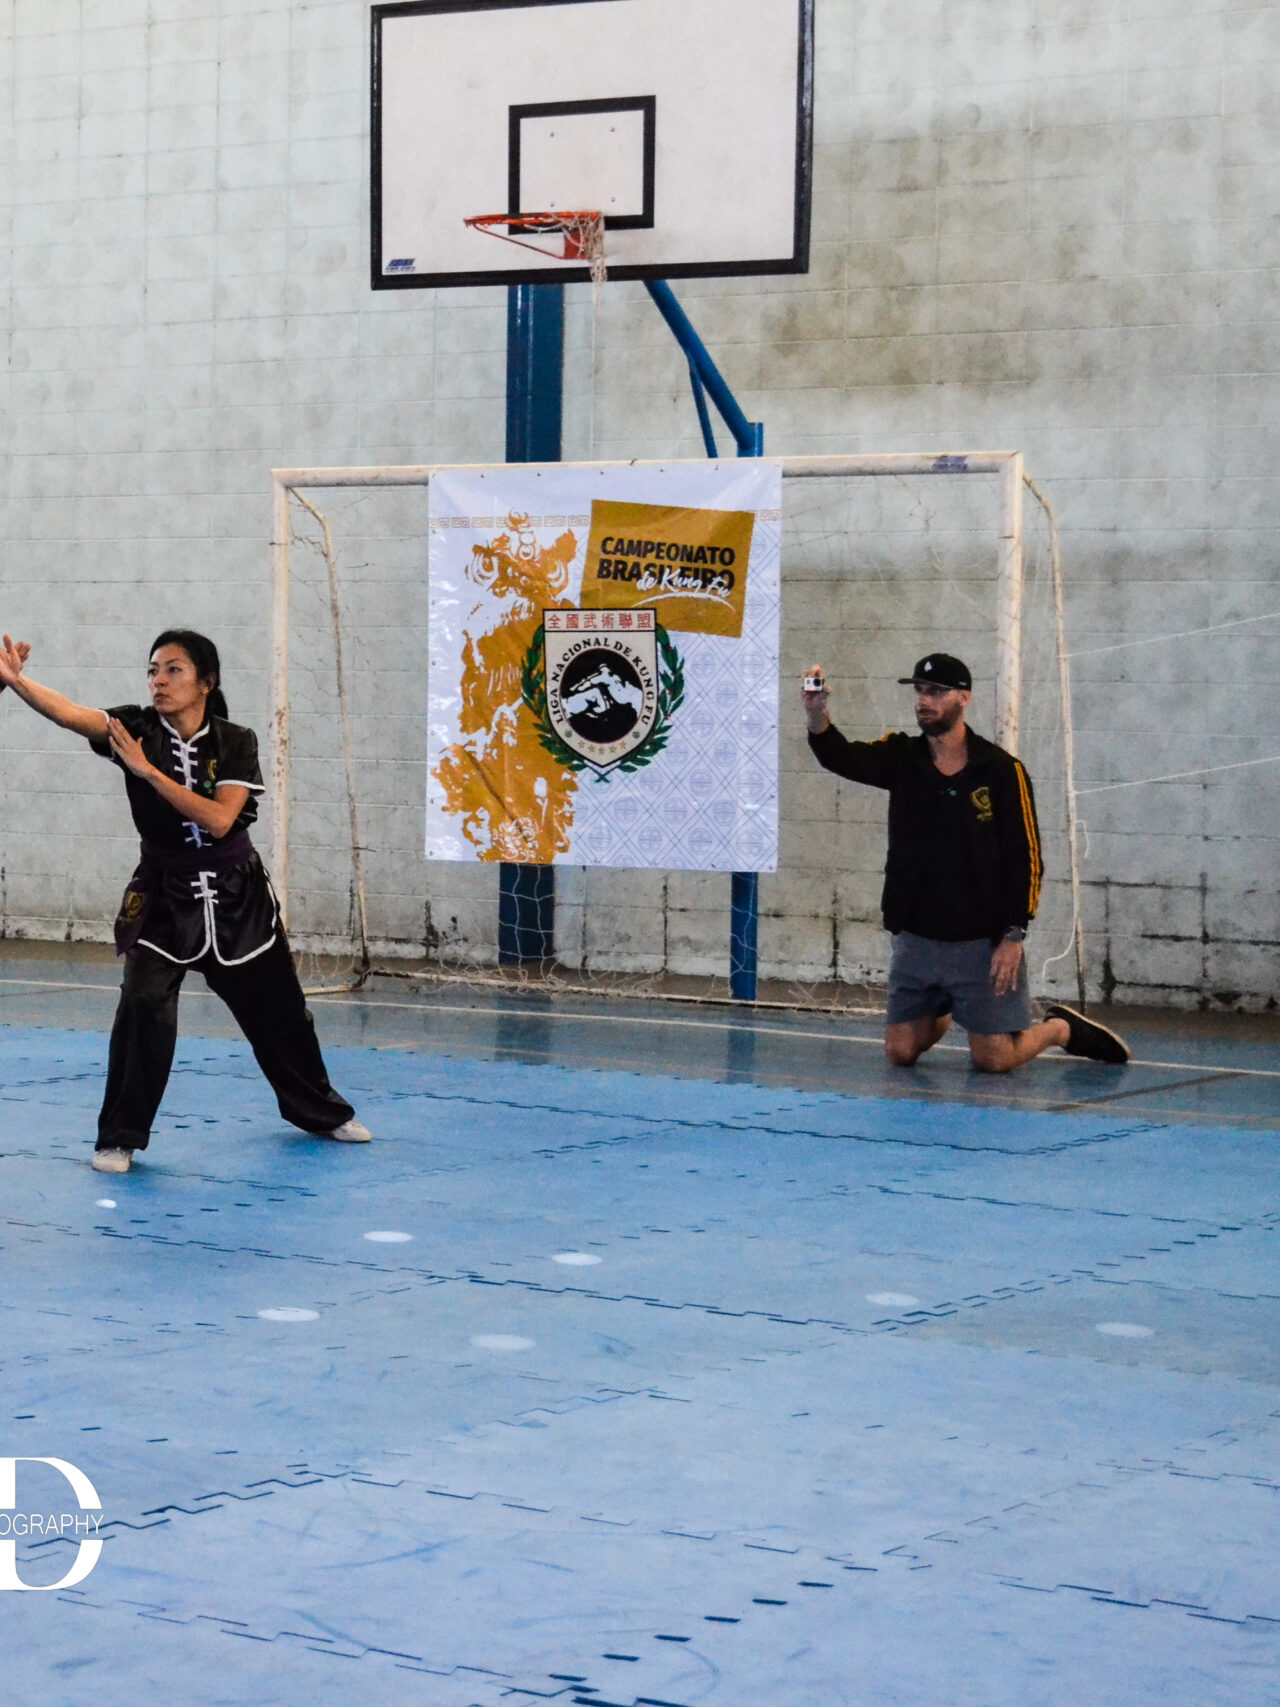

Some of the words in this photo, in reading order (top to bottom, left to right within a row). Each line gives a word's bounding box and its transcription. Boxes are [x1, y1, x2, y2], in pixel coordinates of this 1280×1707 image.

[601, 536, 735, 566] CAMPEONATO
[636, 571, 658, 590] de
[660, 568, 702, 593] Kung
[705, 576, 731, 598] Fu
[548, 613, 652, 629] 全國武術聯盟
[552, 637, 610, 683] NACIONAL
[613, 641, 633, 657] DE
[632, 655, 655, 701] KUNG
[550, 688, 563, 724] LIGA
[641, 706, 653, 725] FU
